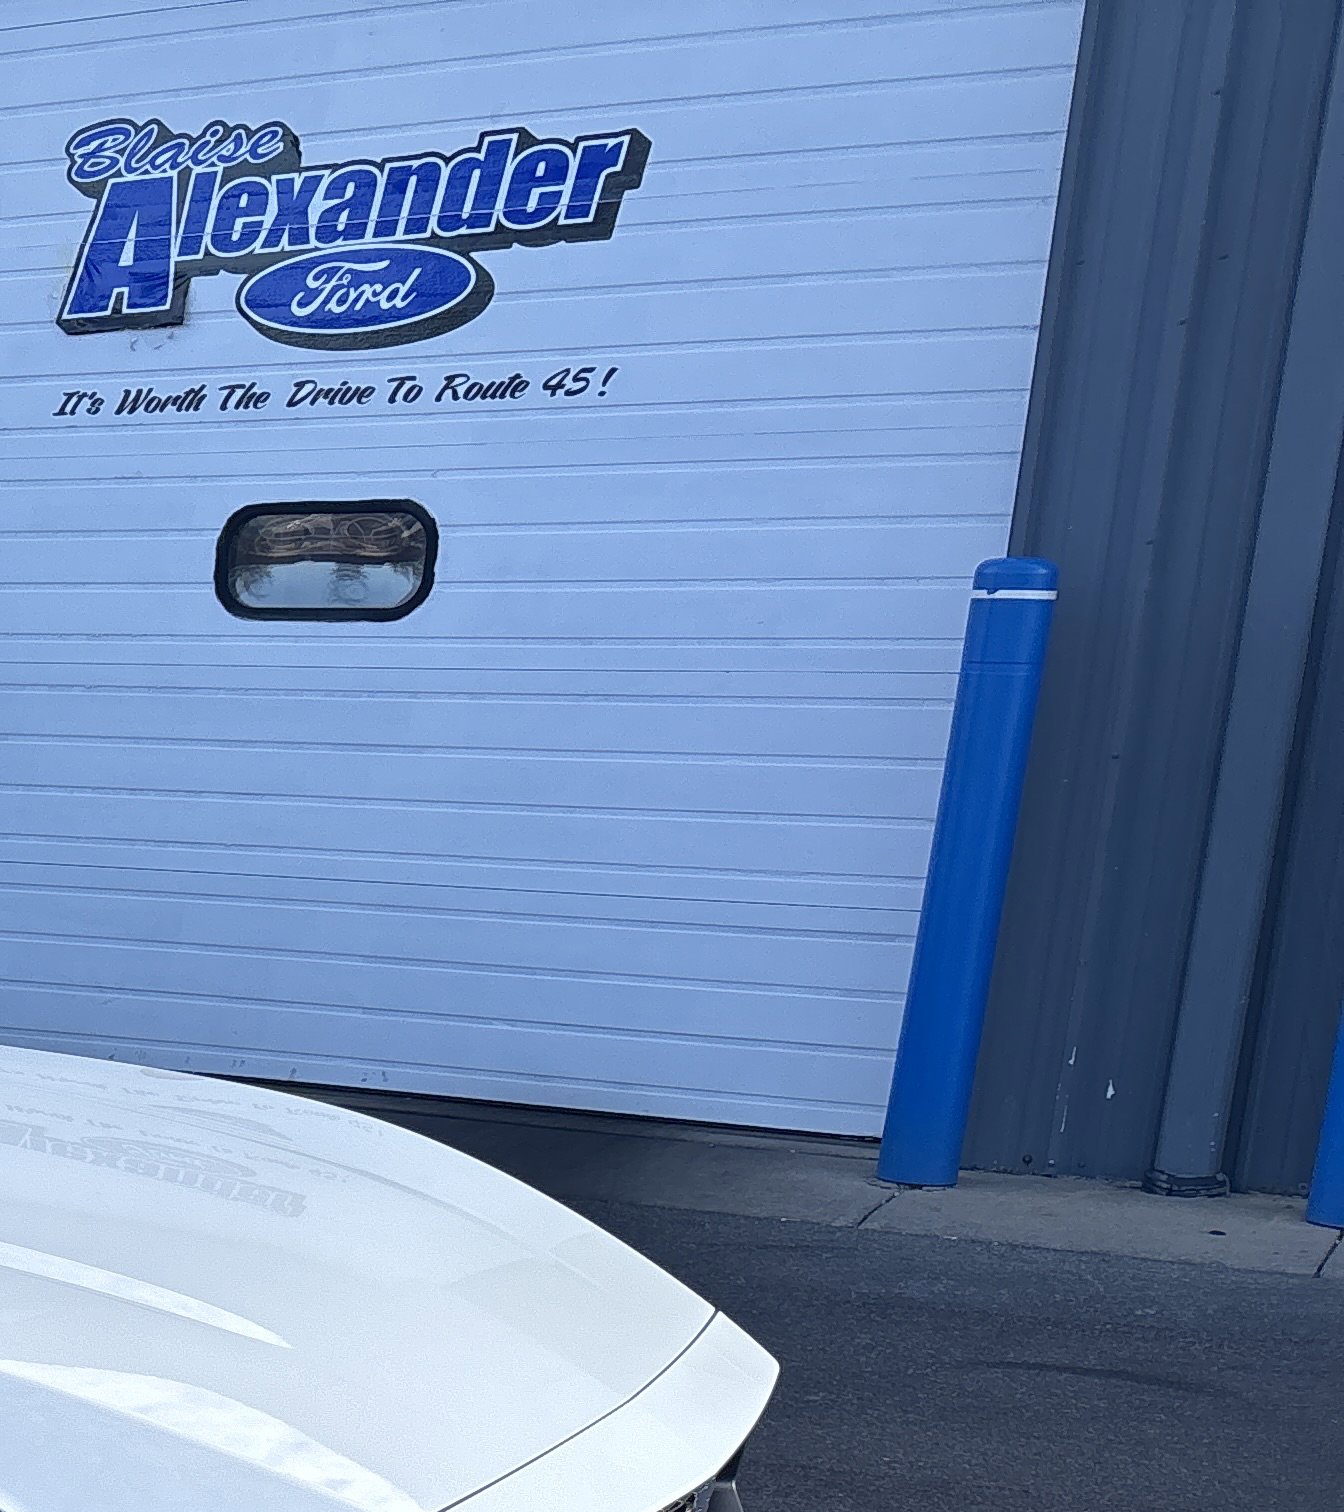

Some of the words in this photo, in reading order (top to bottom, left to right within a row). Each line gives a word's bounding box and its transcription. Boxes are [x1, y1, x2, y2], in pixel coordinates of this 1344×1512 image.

[68, 120, 285, 183] Blaise
[62, 127, 630, 318] Alexander
[291, 261, 420, 317] Ford
[52, 390, 106, 417] It's
[113, 384, 208, 416] Worth
[218, 381, 272, 412] The
[285, 379, 376, 408] Drive
[386, 375, 424, 406] To
[434, 373, 531, 403] Route
